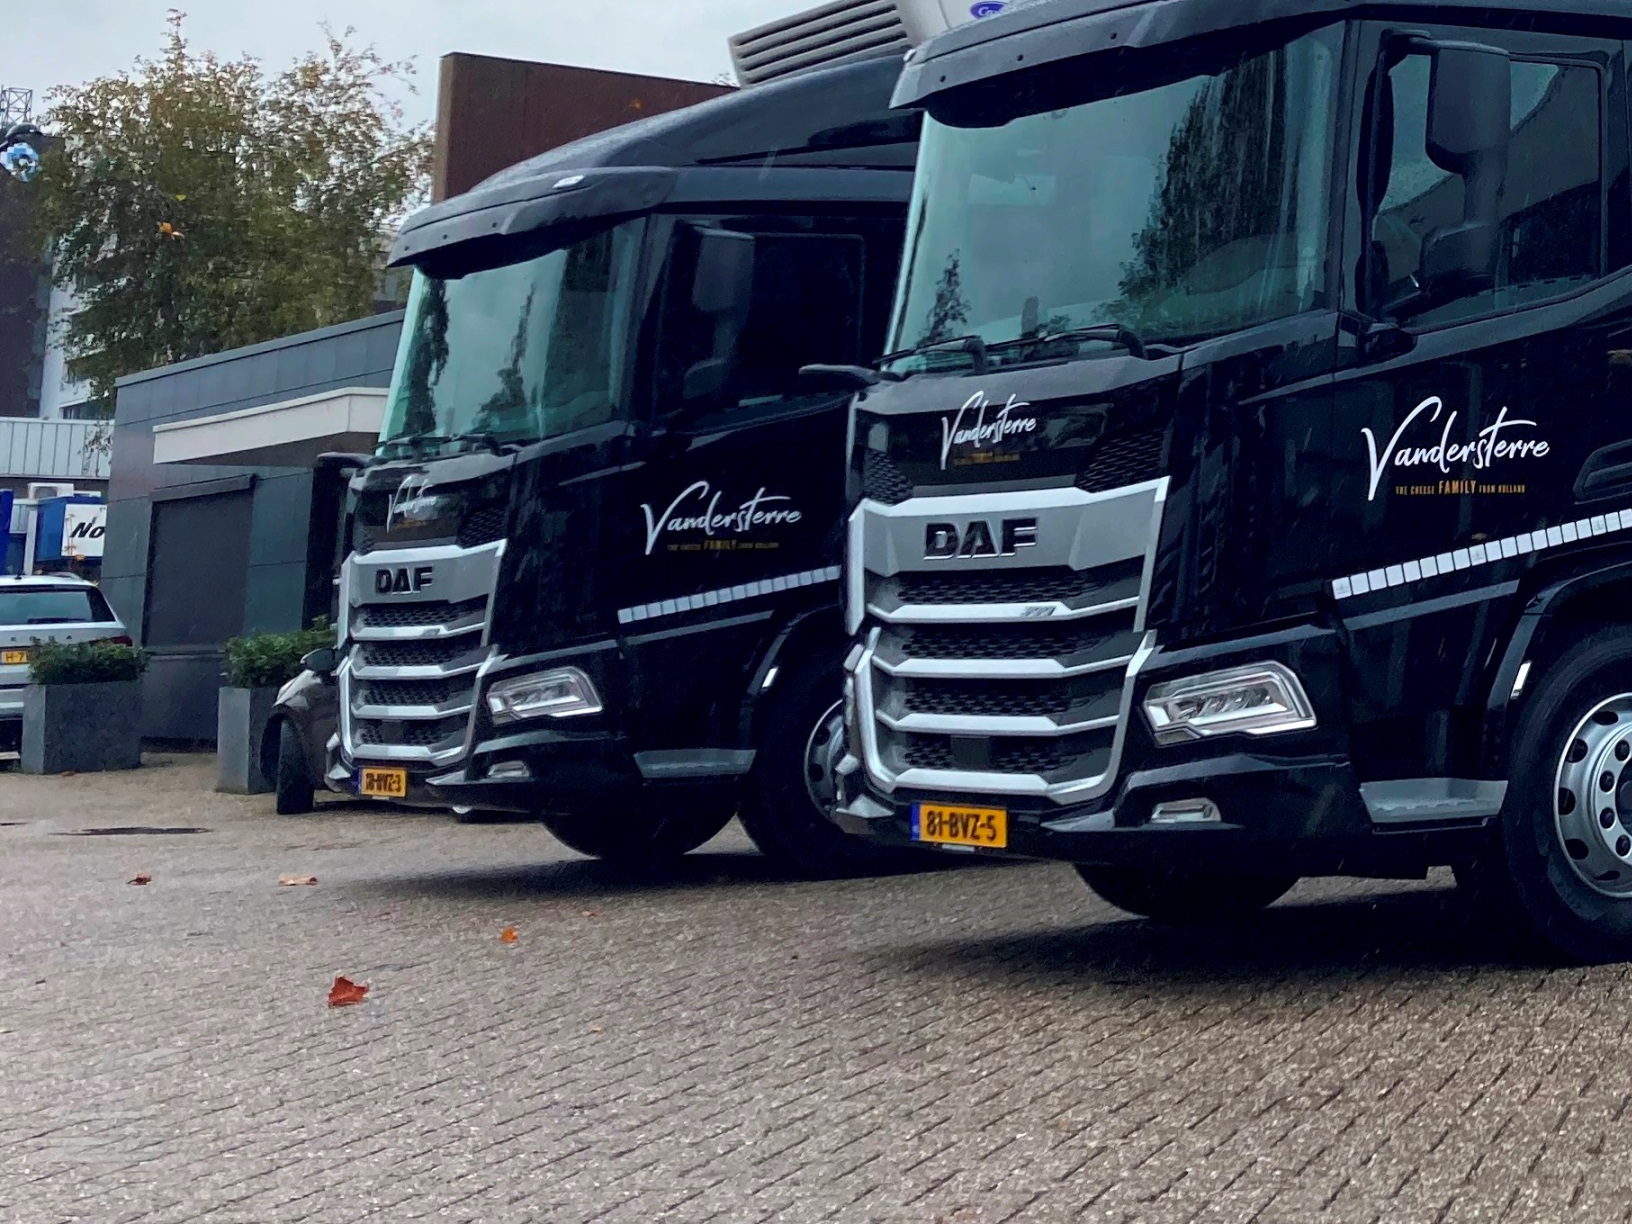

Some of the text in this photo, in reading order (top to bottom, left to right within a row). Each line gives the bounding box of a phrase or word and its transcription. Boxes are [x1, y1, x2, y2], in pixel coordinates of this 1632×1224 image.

[940, 390, 1038, 471] Vandersterre
[1360, 395, 1551, 502] Vandersterre
[1438, 479, 1477, 495] FAMILY
[639, 480, 803, 556] Vandersterre
[923, 516, 1038, 560] DAF
[374, 566, 434, 595] DAF
[926, 810, 997, 842] 81-BVZ-5
